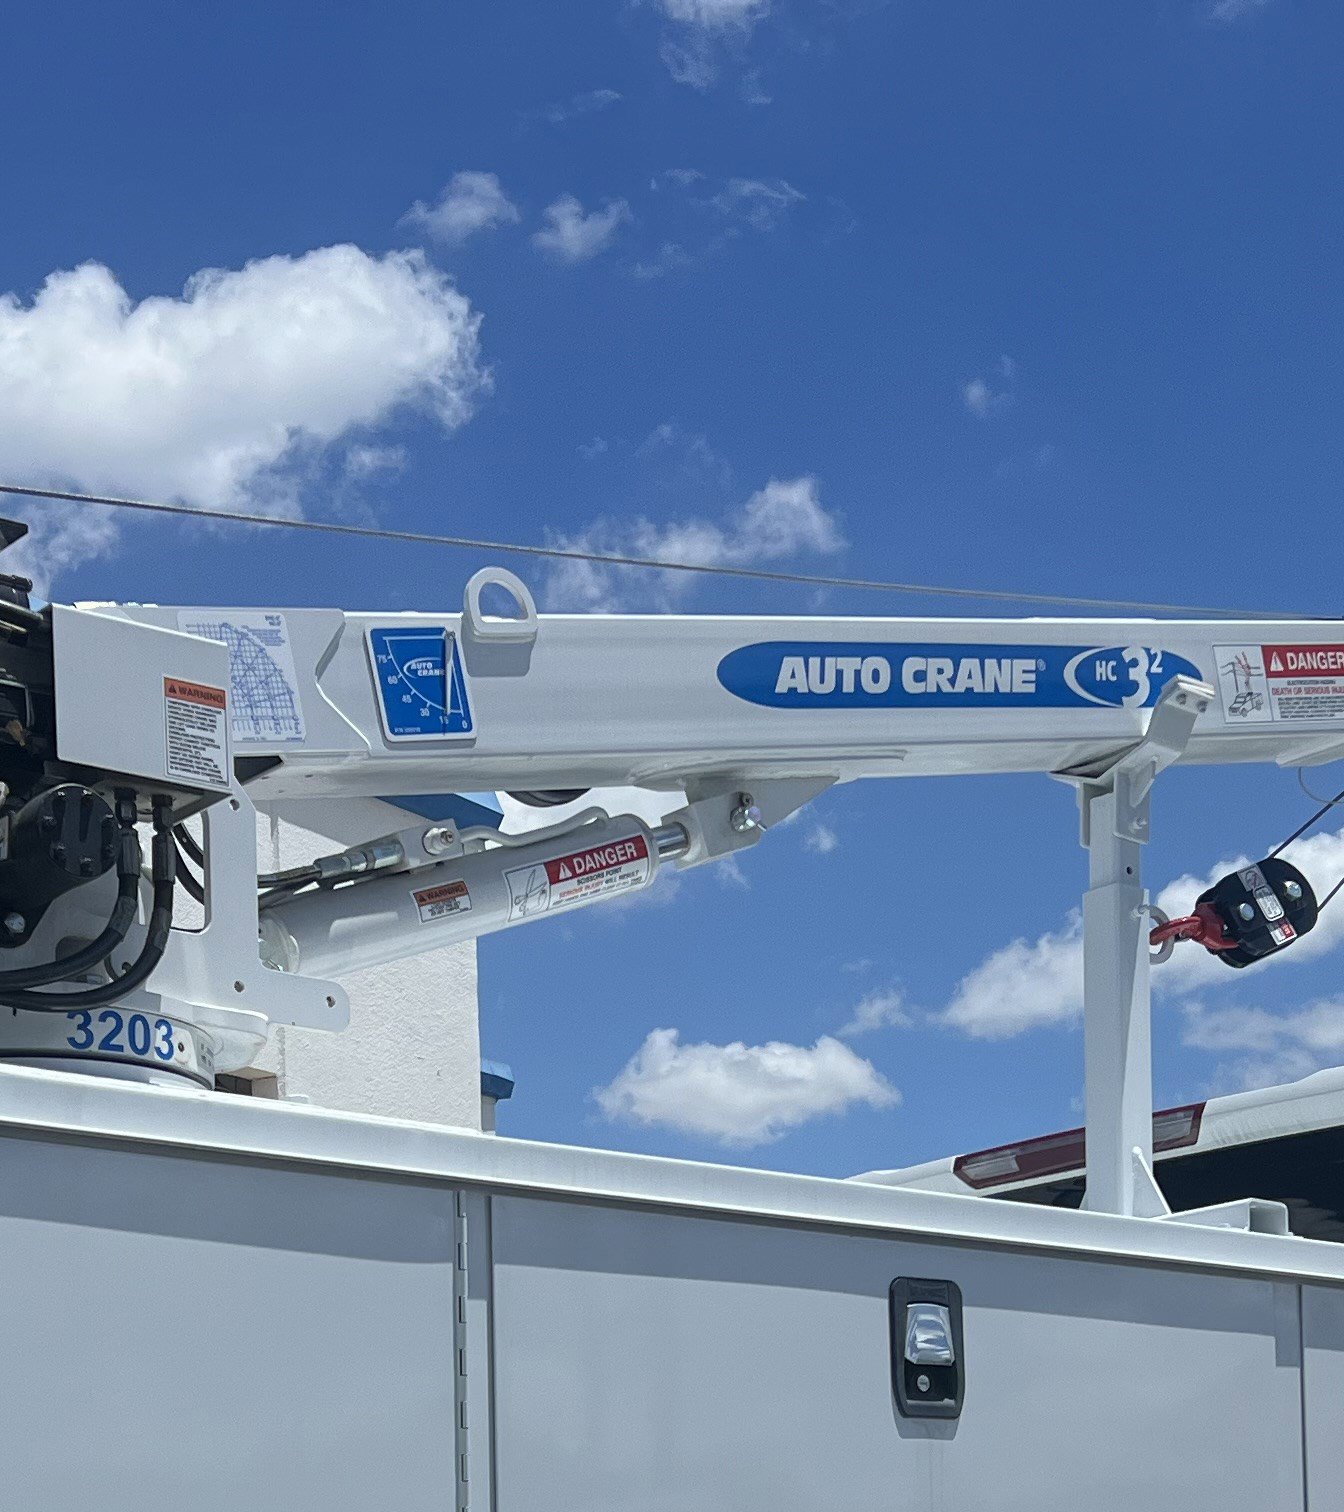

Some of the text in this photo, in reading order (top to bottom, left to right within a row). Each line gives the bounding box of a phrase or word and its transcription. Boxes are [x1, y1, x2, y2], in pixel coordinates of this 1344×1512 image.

[377, 654, 387, 663] 75
[411, 662, 432, 670] AUTO
[388, 675, 398, 684] 60
[774, 656, 892, 695] AUTO
[901, 656, 1036, 694] CRANE
[1095, 660, 1118, 682] HC
[177, 686, 223, 703] WARNING
[420, 708, 429, 717] 30
[462, 720, 468, 729] 0
[573, 842, 637, 874] DANGER
[427, 885, 465, 900] WARNING
[66, 1010, 174, 1060] 3203
